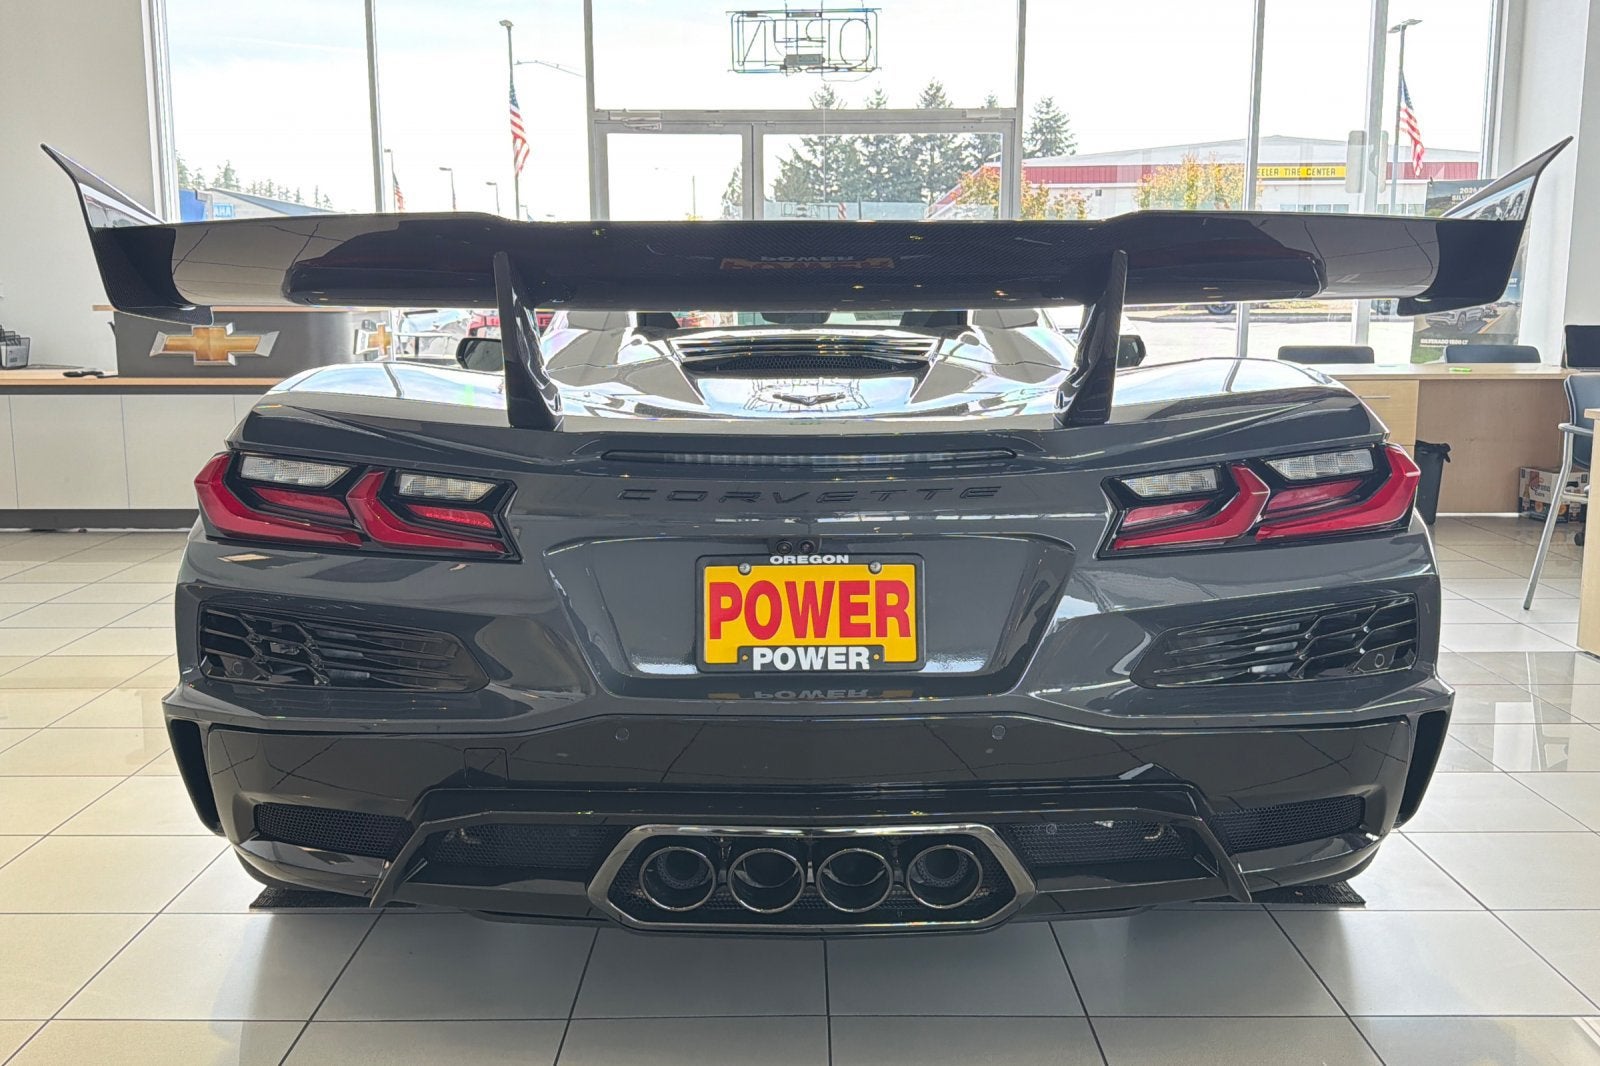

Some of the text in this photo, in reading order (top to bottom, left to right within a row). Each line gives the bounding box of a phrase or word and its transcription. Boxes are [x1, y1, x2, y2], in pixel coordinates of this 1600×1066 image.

[1283, 167, 1301, 177] TIRE
[1305, 167, 1336, 177] CENTER
[616, 485, 1002, 504] CORVETTE
[769, 554, 850, 565] OREGON
[708, 580, 912, 641] POWER
[752, 646, 870, 671] POWER
